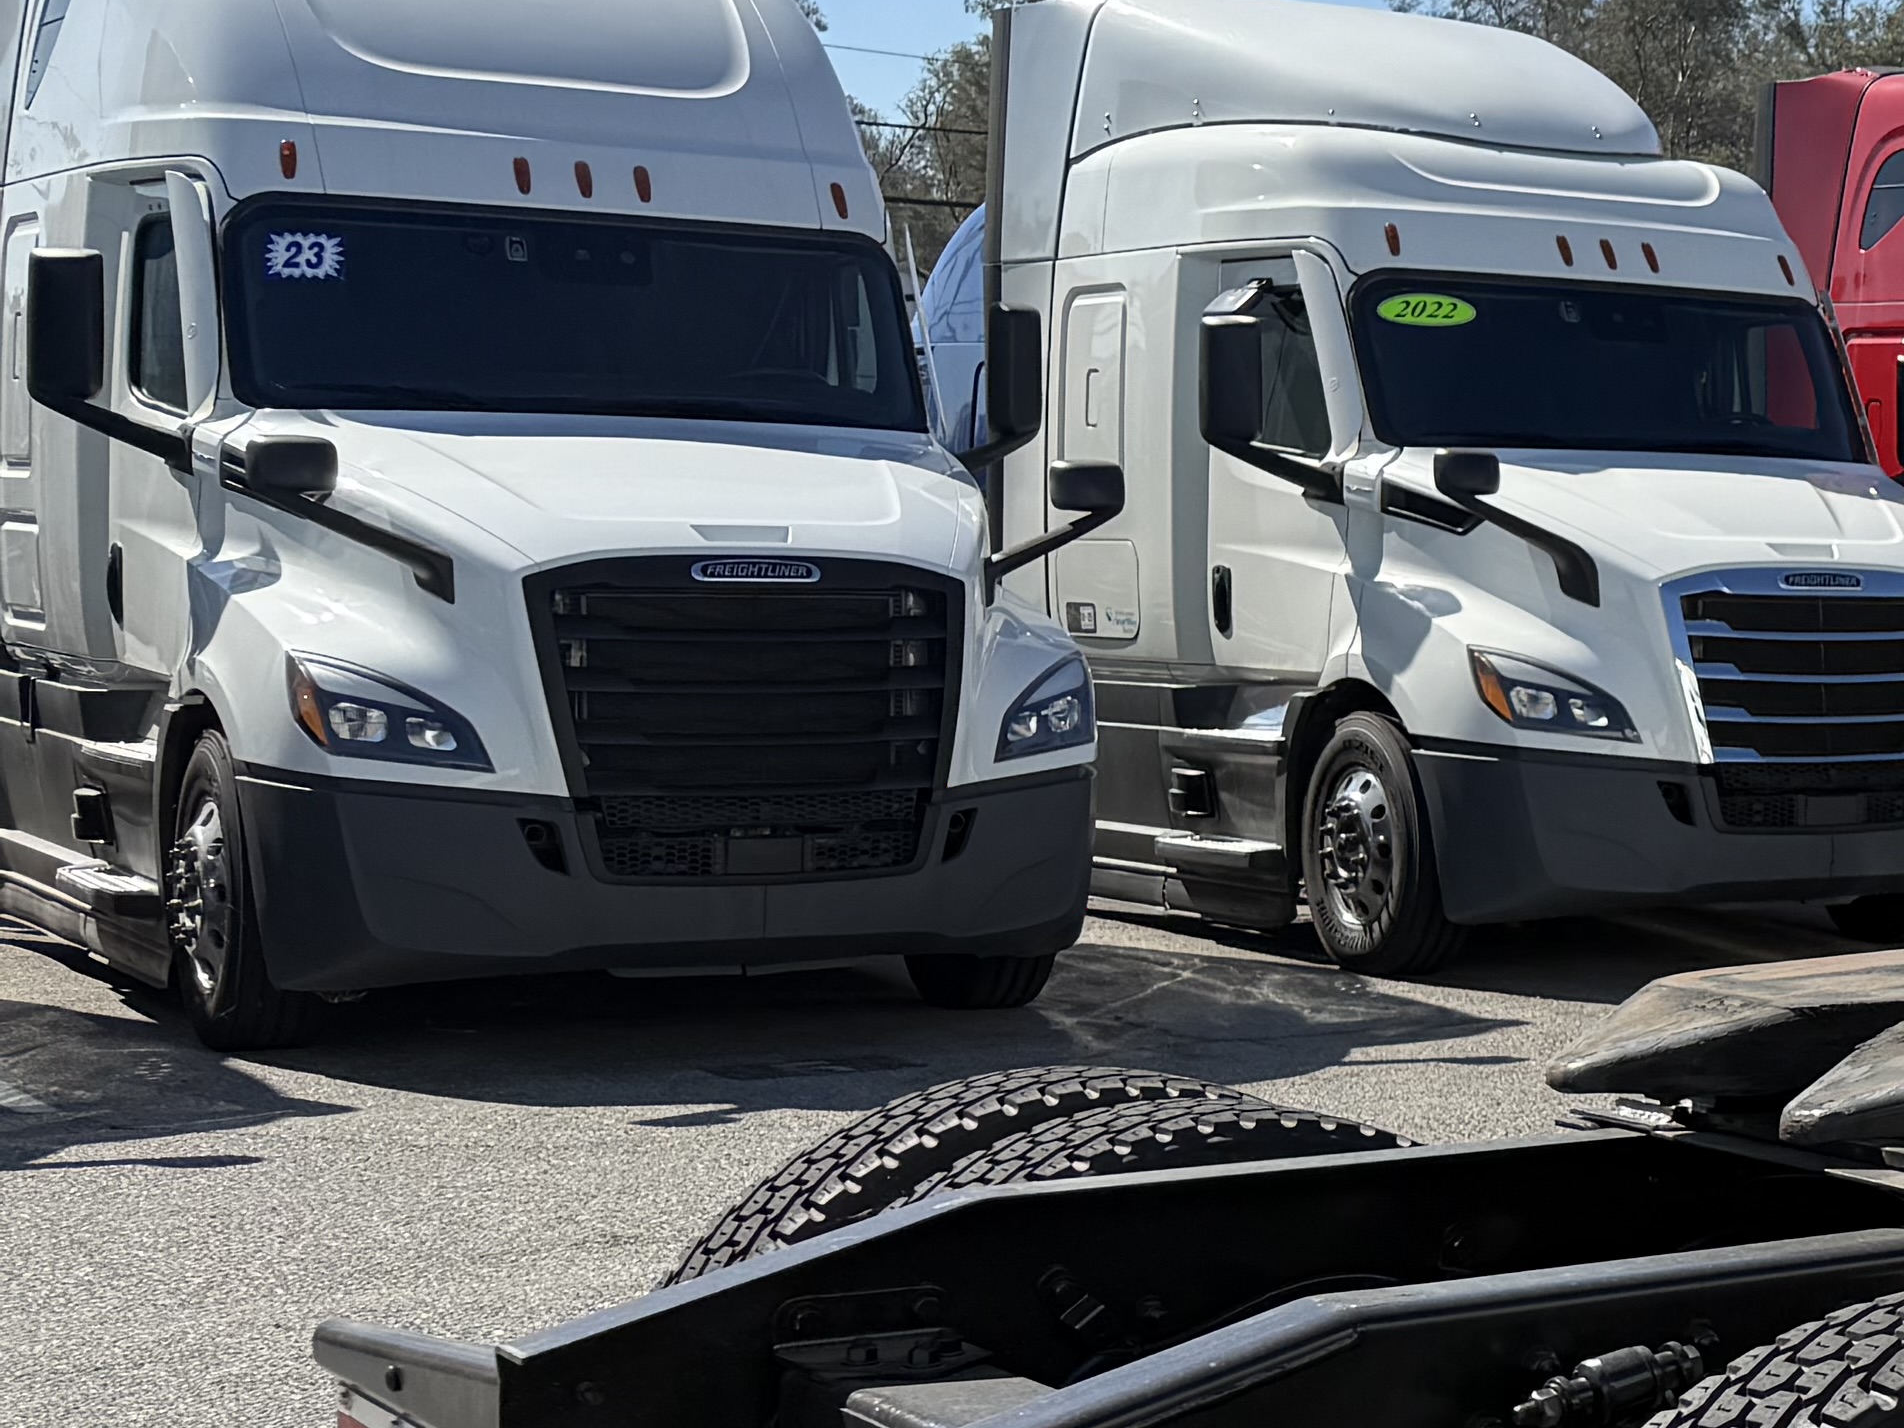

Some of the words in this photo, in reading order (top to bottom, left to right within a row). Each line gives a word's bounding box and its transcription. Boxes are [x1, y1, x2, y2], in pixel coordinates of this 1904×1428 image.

[282, 240, 325, 270] 23
[1394, 299, 1458, 319] 2022
[706, 563, 808, 577] FREIGHTLINER
